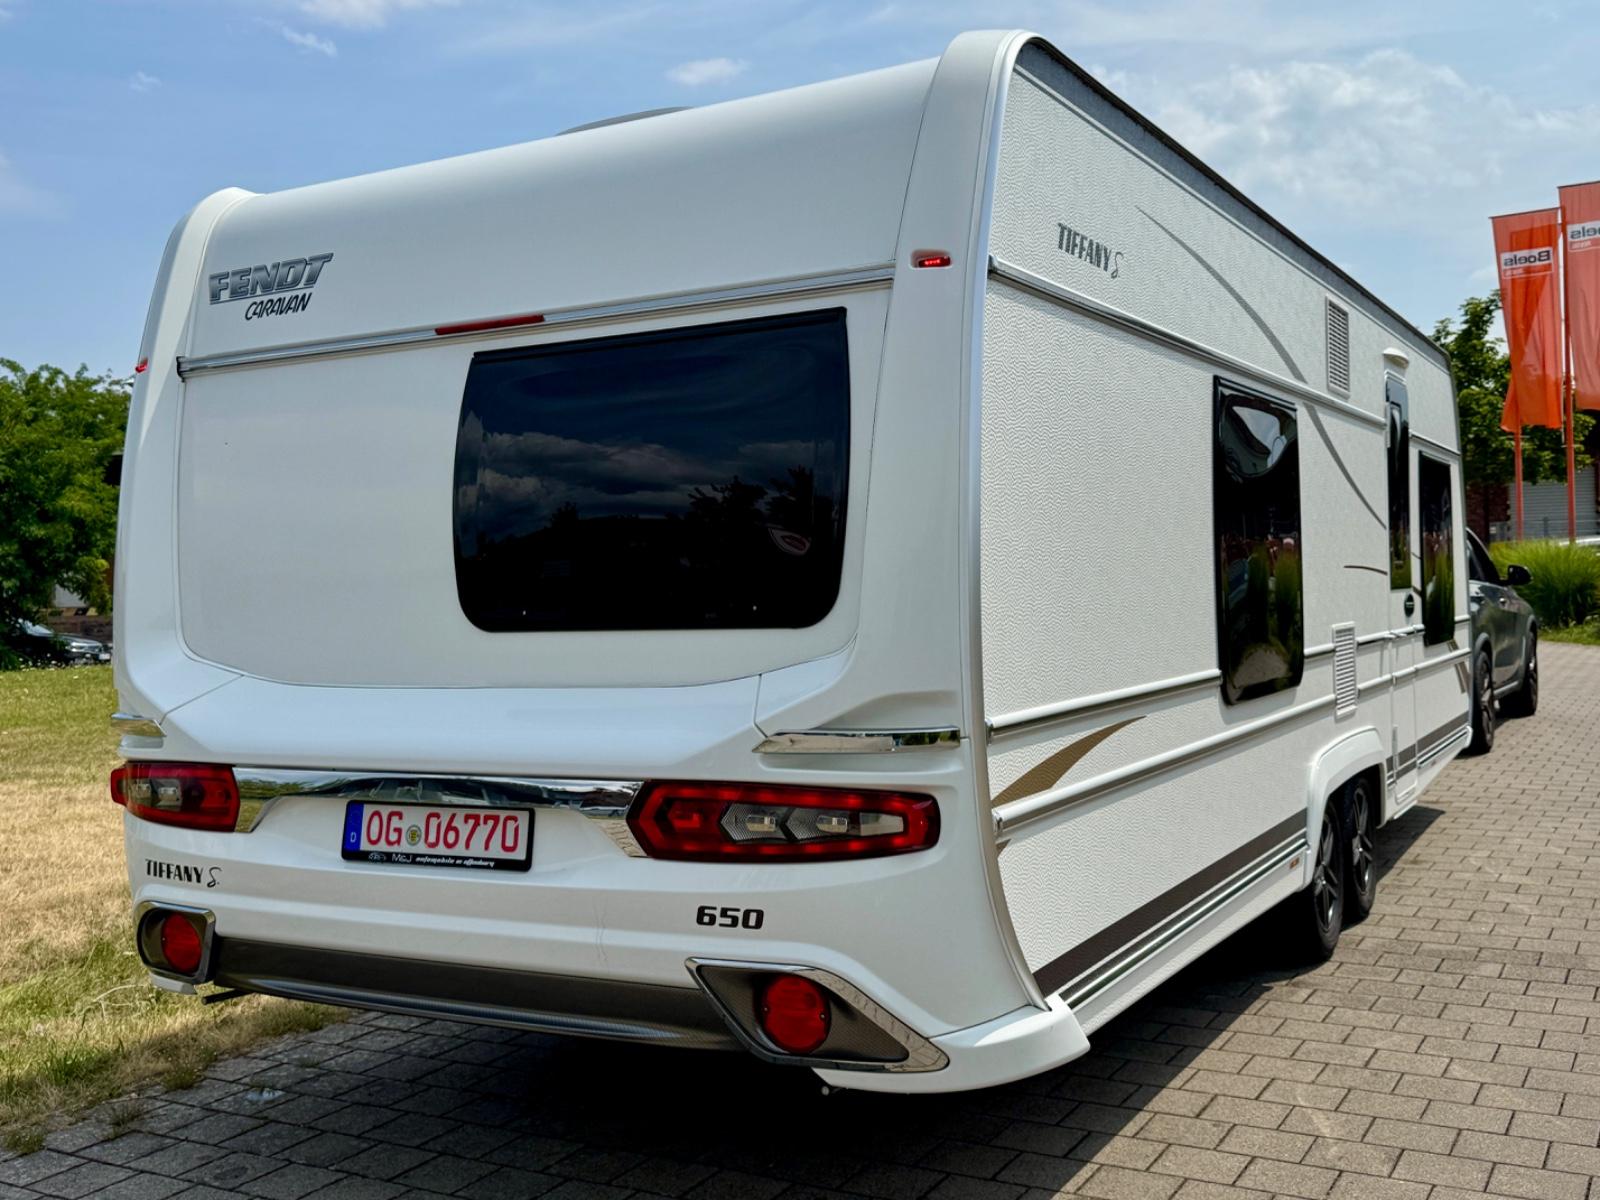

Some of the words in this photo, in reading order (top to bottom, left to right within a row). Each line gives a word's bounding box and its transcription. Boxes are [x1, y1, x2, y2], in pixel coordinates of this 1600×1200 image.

[1058, 222, 1112, 272] TIFFANY
[208, 252, 334, 302] FENDT
[244, 292, 313, 321] CARAVAN
[366, 810, 403, 847] OG
[424, 812, 519, 853] 06770
[145, 858, 204, 884] TIFFANY
[696, 905, 764, 930] 650
